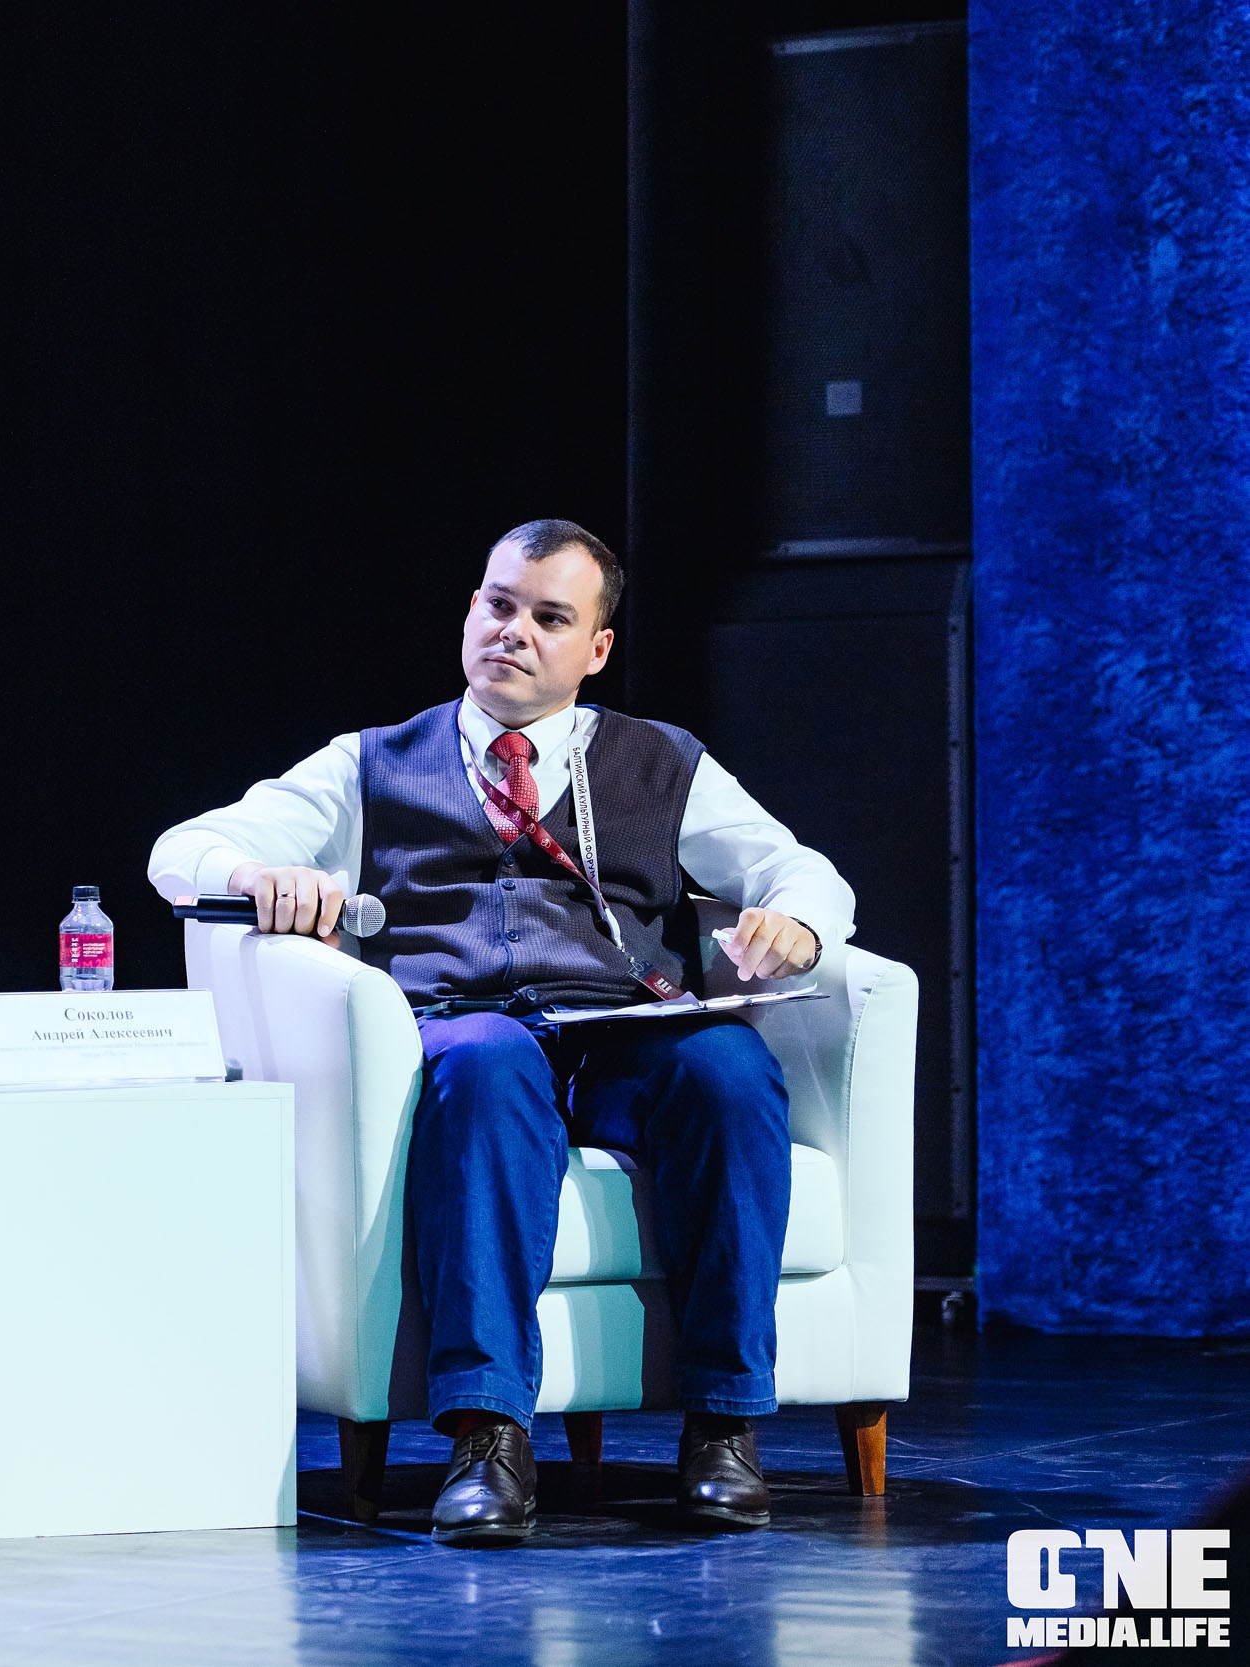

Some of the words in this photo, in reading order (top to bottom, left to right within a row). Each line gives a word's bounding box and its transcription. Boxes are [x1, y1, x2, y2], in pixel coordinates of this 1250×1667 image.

[572, 746, 587, 795] БАЛТИЙСКИЙ
[578, 795, 593, 844] КУЛЬТУРНЫЙ
[585, 844, 596, 880] ФОРУМ
[64, 1007, 135, 1021] Соколов
[31, 1028, 85, 1043] Андрей
[89, 1028, 173, 1040] Алексеевич
